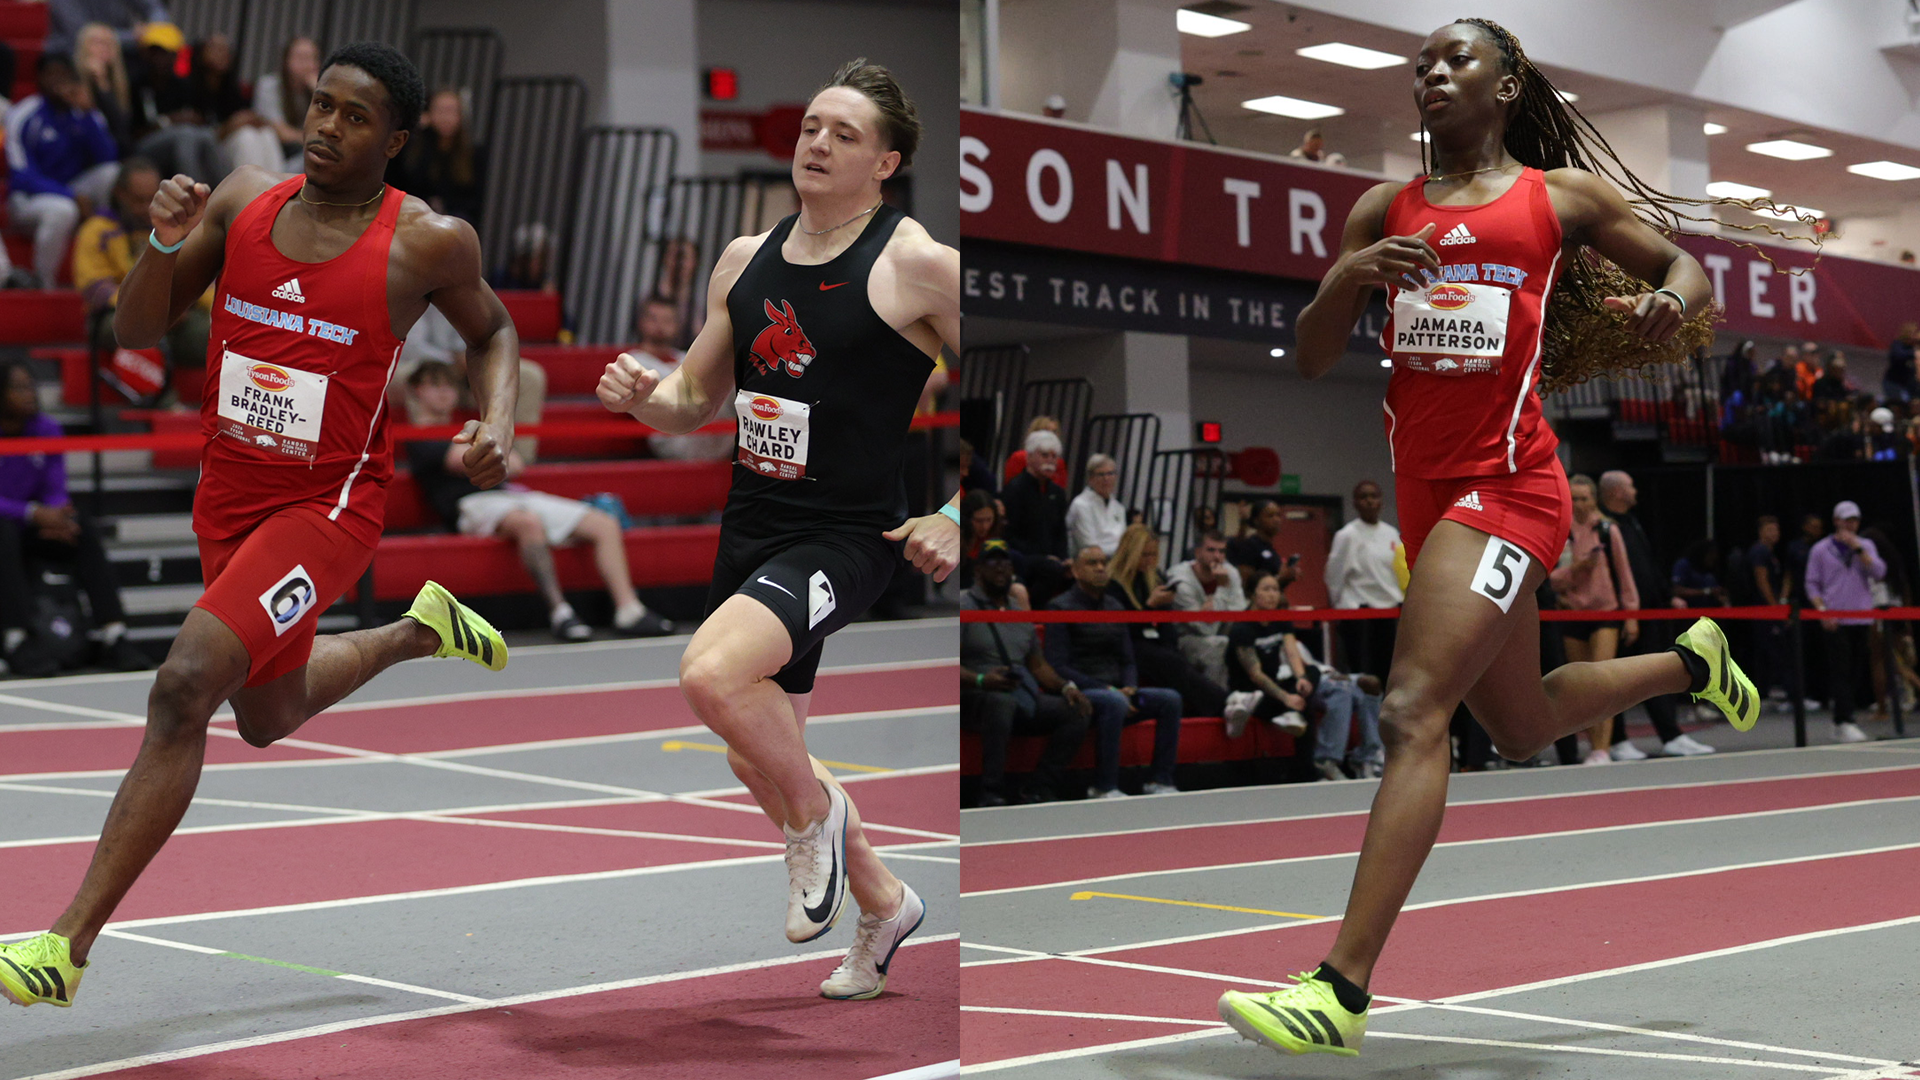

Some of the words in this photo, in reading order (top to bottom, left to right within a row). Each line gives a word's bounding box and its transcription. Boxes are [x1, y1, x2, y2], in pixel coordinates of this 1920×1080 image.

[960, 136, 1150, 234] SON
[1439, 235, 1477, 246] adidas
[1482, 263, 1527, 286] TECH
[272, 289, 306, 304] adidas
[965, 269, 1028, 301] EST
[1050, 278, 1160, 316] TRACK
[1178, 292, 1211, 321] IN
[1229, 299, 1286, 329] THE
[1704, 254, 1819, 324] TER
[224, 294, 304, 333] LOUISIANA
[308, 318, 357, 346] TECH
[1410, 317, 1485, 334] JAMARA
[1397, 333, 1500, 350] PATTERSON
[231, 395, 307, 424] BRADLEY-
[244, 386, 295, 410] FRANK
[246, 413, 285, 434] REED
[743, 415, 802, 444] RAWLEY
[746, 434, 795, 460] CHARD
[1453, 501, 1484, 511] adidas
[1483, 543, 1522, 600] 5
[270, 577, 311, 624] 6
